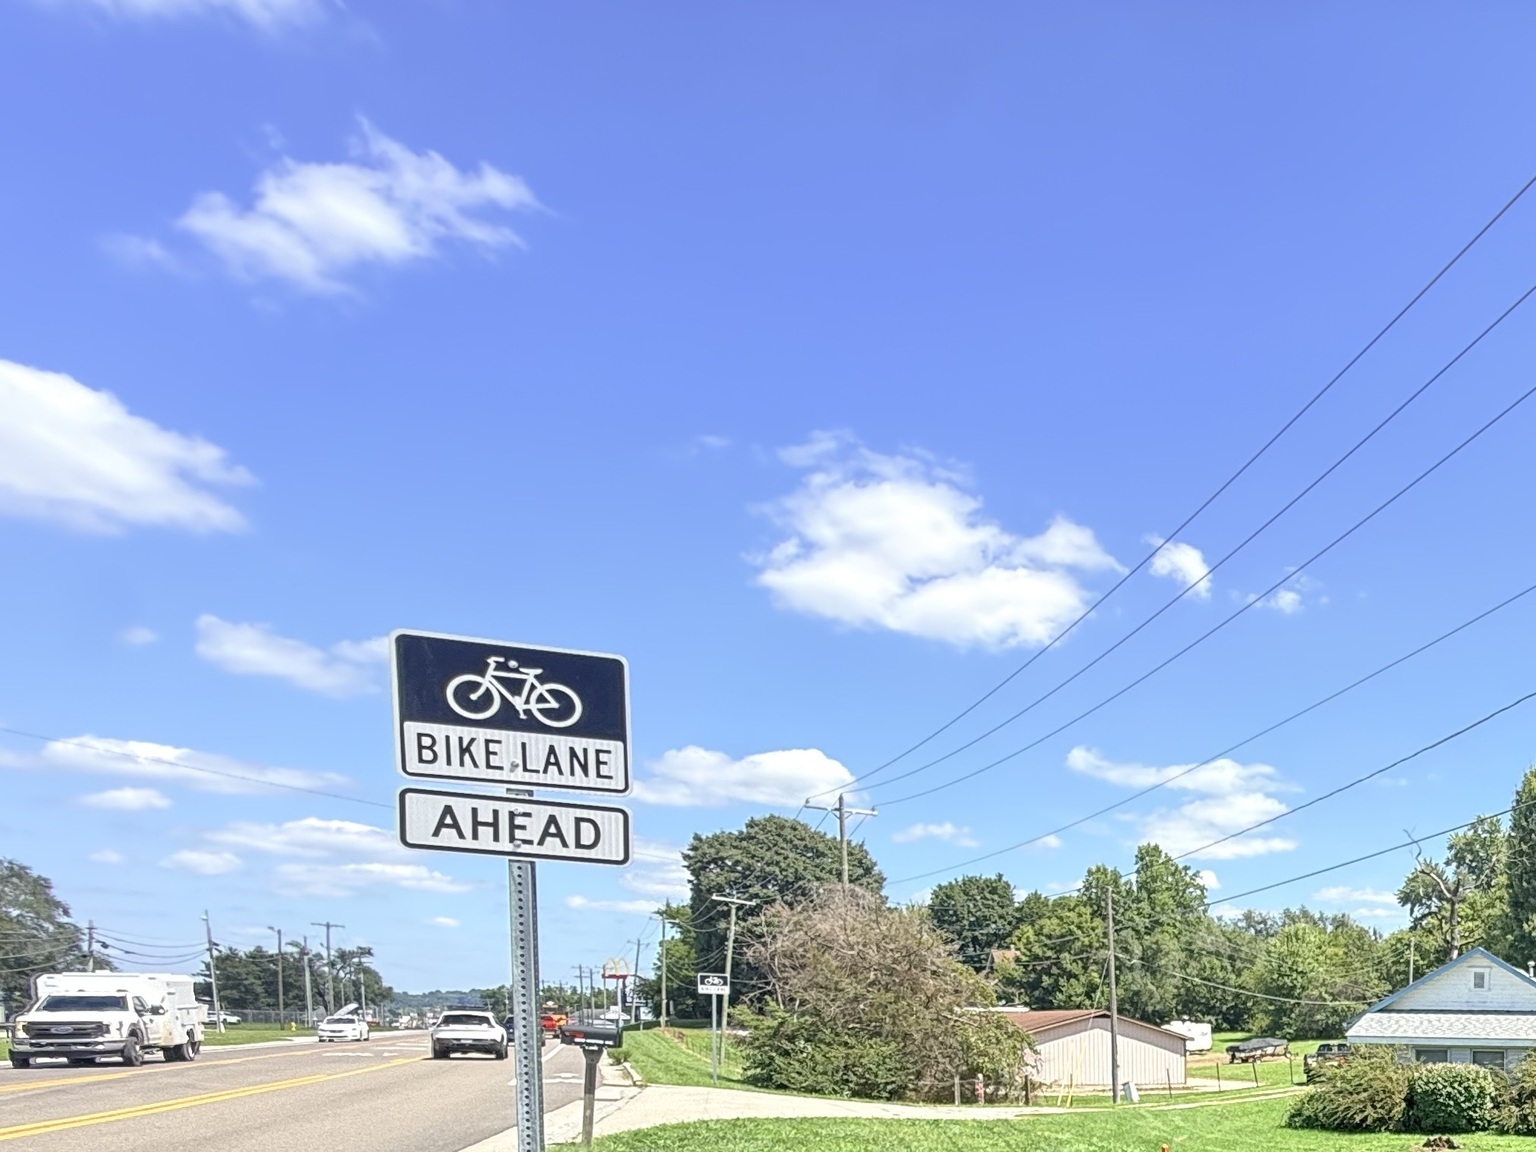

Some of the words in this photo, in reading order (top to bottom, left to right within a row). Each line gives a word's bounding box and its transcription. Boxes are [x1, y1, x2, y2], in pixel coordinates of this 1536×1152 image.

[416, 732, 504, 771] BIKE
[520, 741, 614, 780] LANE
[431, 804, 601, 851] AHEAD
